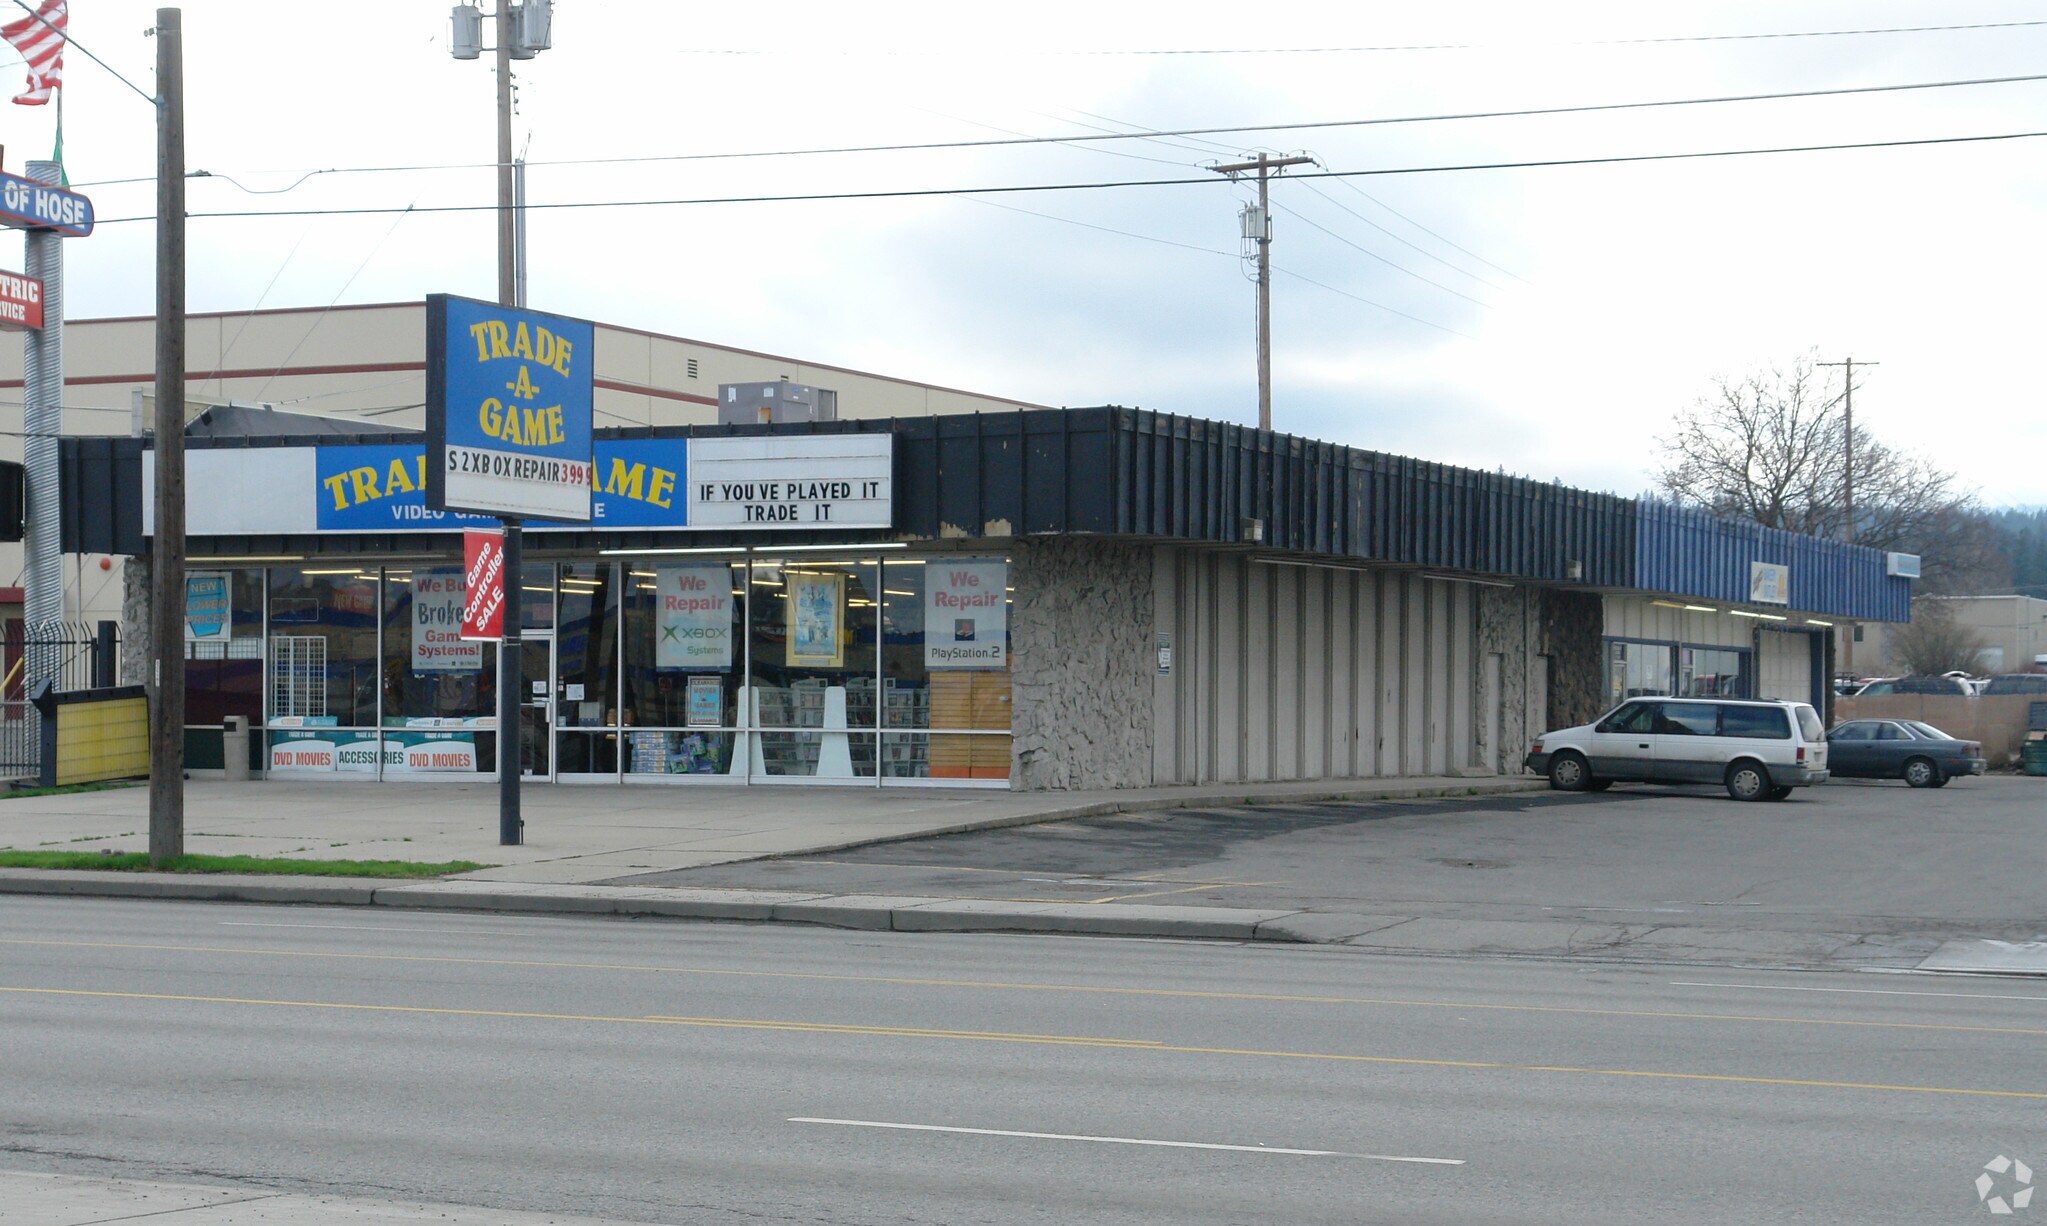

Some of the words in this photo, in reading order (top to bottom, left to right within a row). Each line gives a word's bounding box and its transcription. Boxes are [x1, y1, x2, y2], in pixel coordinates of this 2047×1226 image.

[5, 180, 30, 212] OF
[35, 188, 85, 229] HOSE
[0, 300, 25, 320] VICE
[470, 320, 572, 378] TRADE
[479, 398, 565, 446] GAME
[700, 485, 714, 500] IF
[788, 483, 850, 500] PLAYED
[863, 482, 879, 499] IT
[745, 505, 798, 521] TRADE
[815, 504, 831, 520] IT
[467, 542, 491, 588] Game
[191, 582, 217, 592] NEW
[417, 578, 441, 592] We
[463, 546, 504, 623] Controller
[679, 576, 706, 592] We
[949, 571, 979, 587] We
[186, 599, 227, 610] LOWER
[476, 586, 504, 632] SALE
[665, 595, 725, 614] Repair
[935, 591, 999, 611] Repair
[185, 614, 228, 625] PRICES
[418, 644, 479, 659] Systems!
[687, 646, 724, 656] Systems
[274, 752, 293, 765] DVD
[296, 752, 331, 766] MOVIES
[409, 753, 429, 767] DVD
[432, 753, 471, 767] MOVIES
